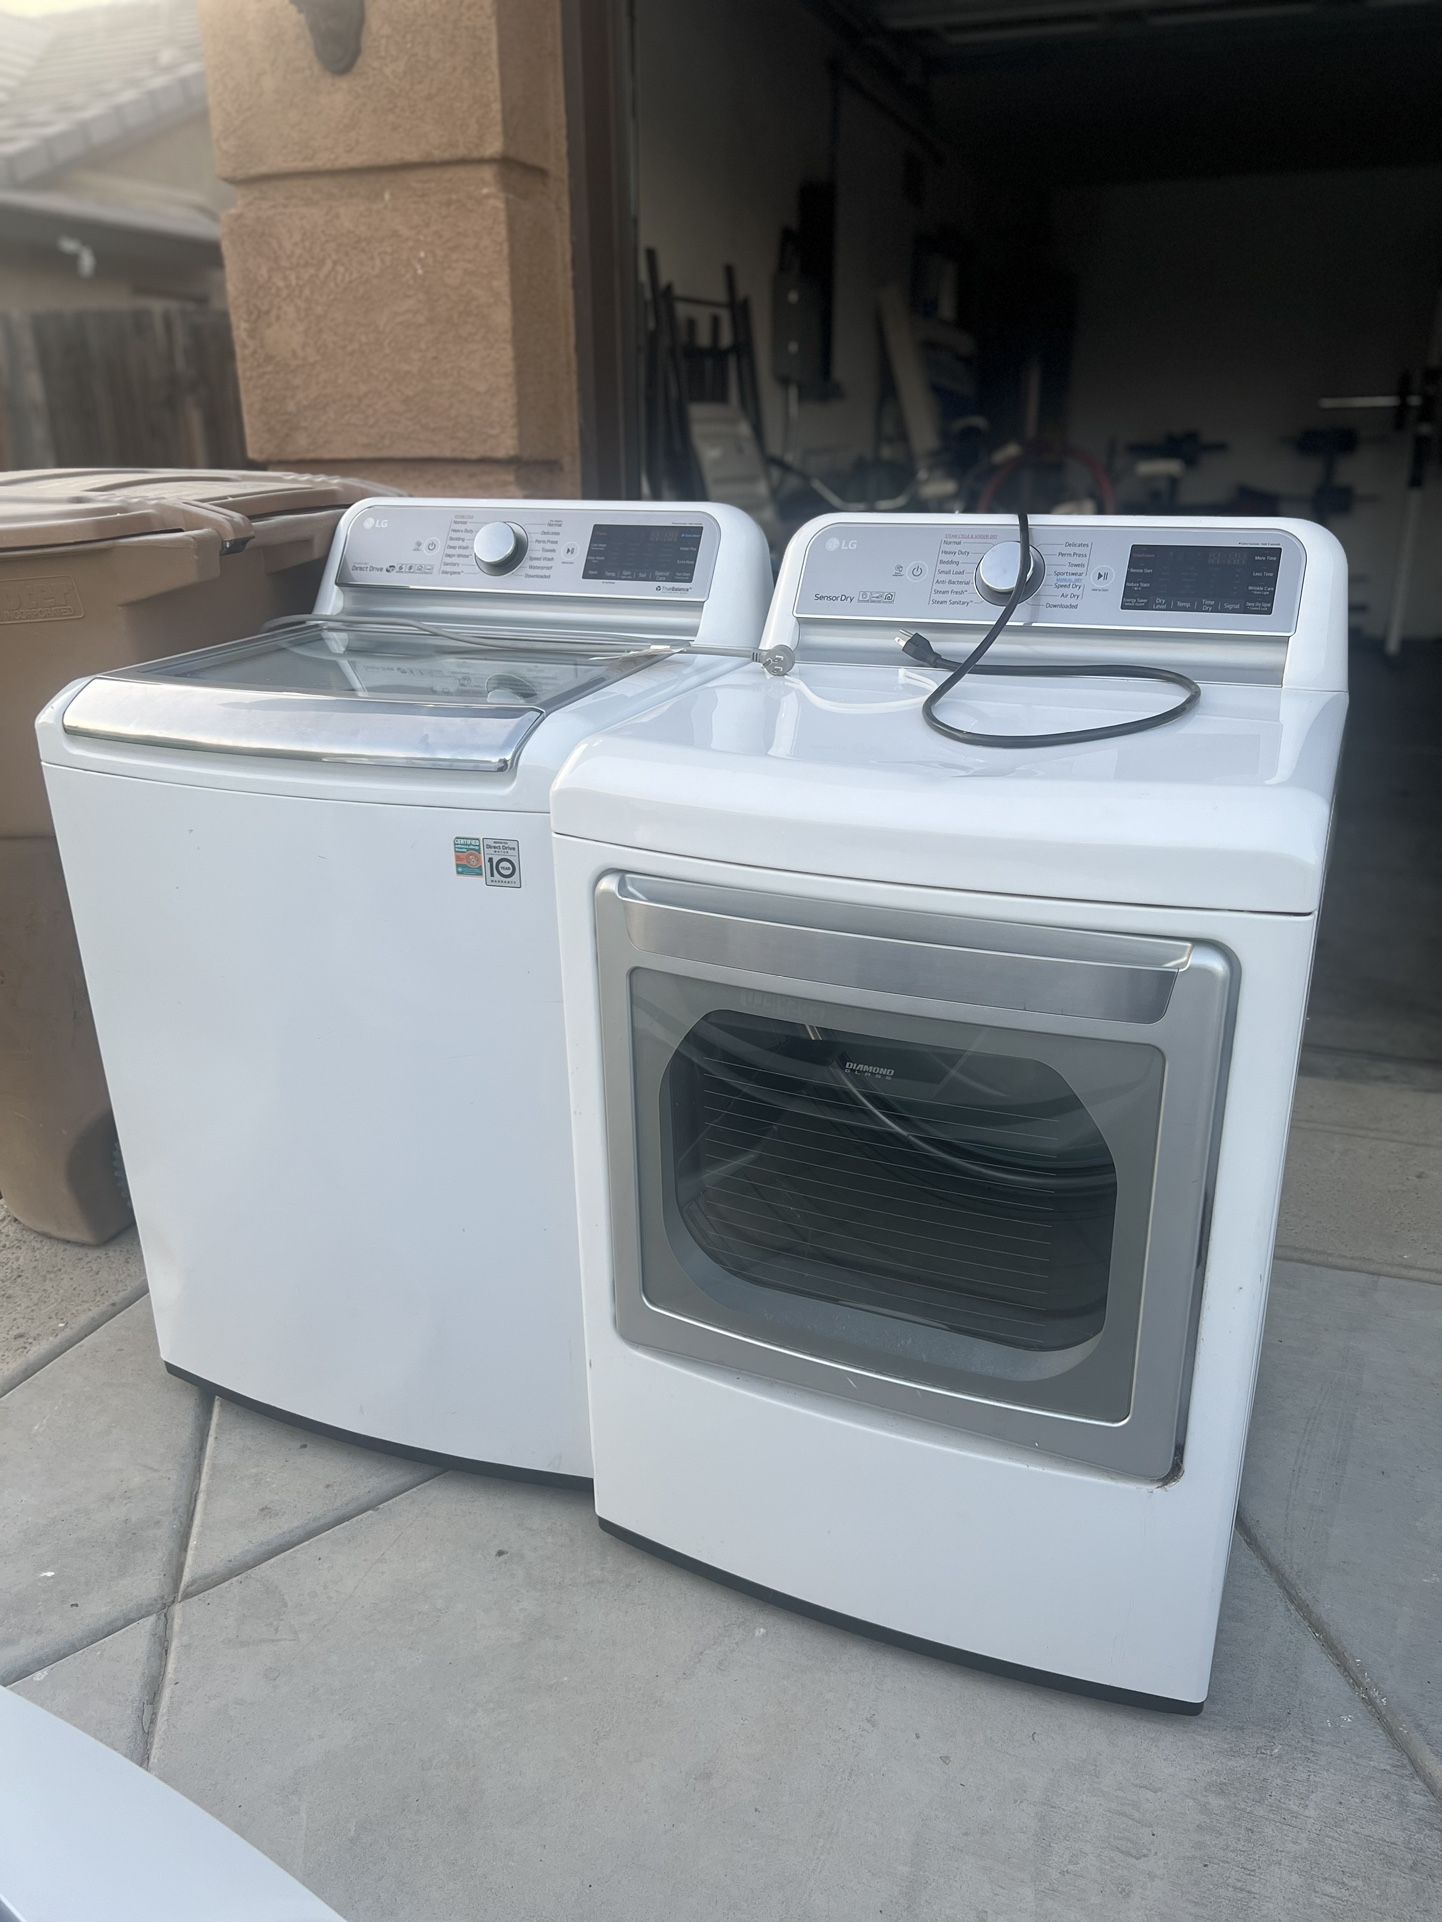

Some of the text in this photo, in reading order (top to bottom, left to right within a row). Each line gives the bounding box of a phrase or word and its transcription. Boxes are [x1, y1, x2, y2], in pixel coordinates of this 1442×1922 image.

[375, 520, 388, 528] LG
[841, 540, 857, 549] LG
[488, 856, 516, 879] 10
[844, 1068, 892, 1081] GLASS
[845, 1061, 895, 1076] DIAMOND
